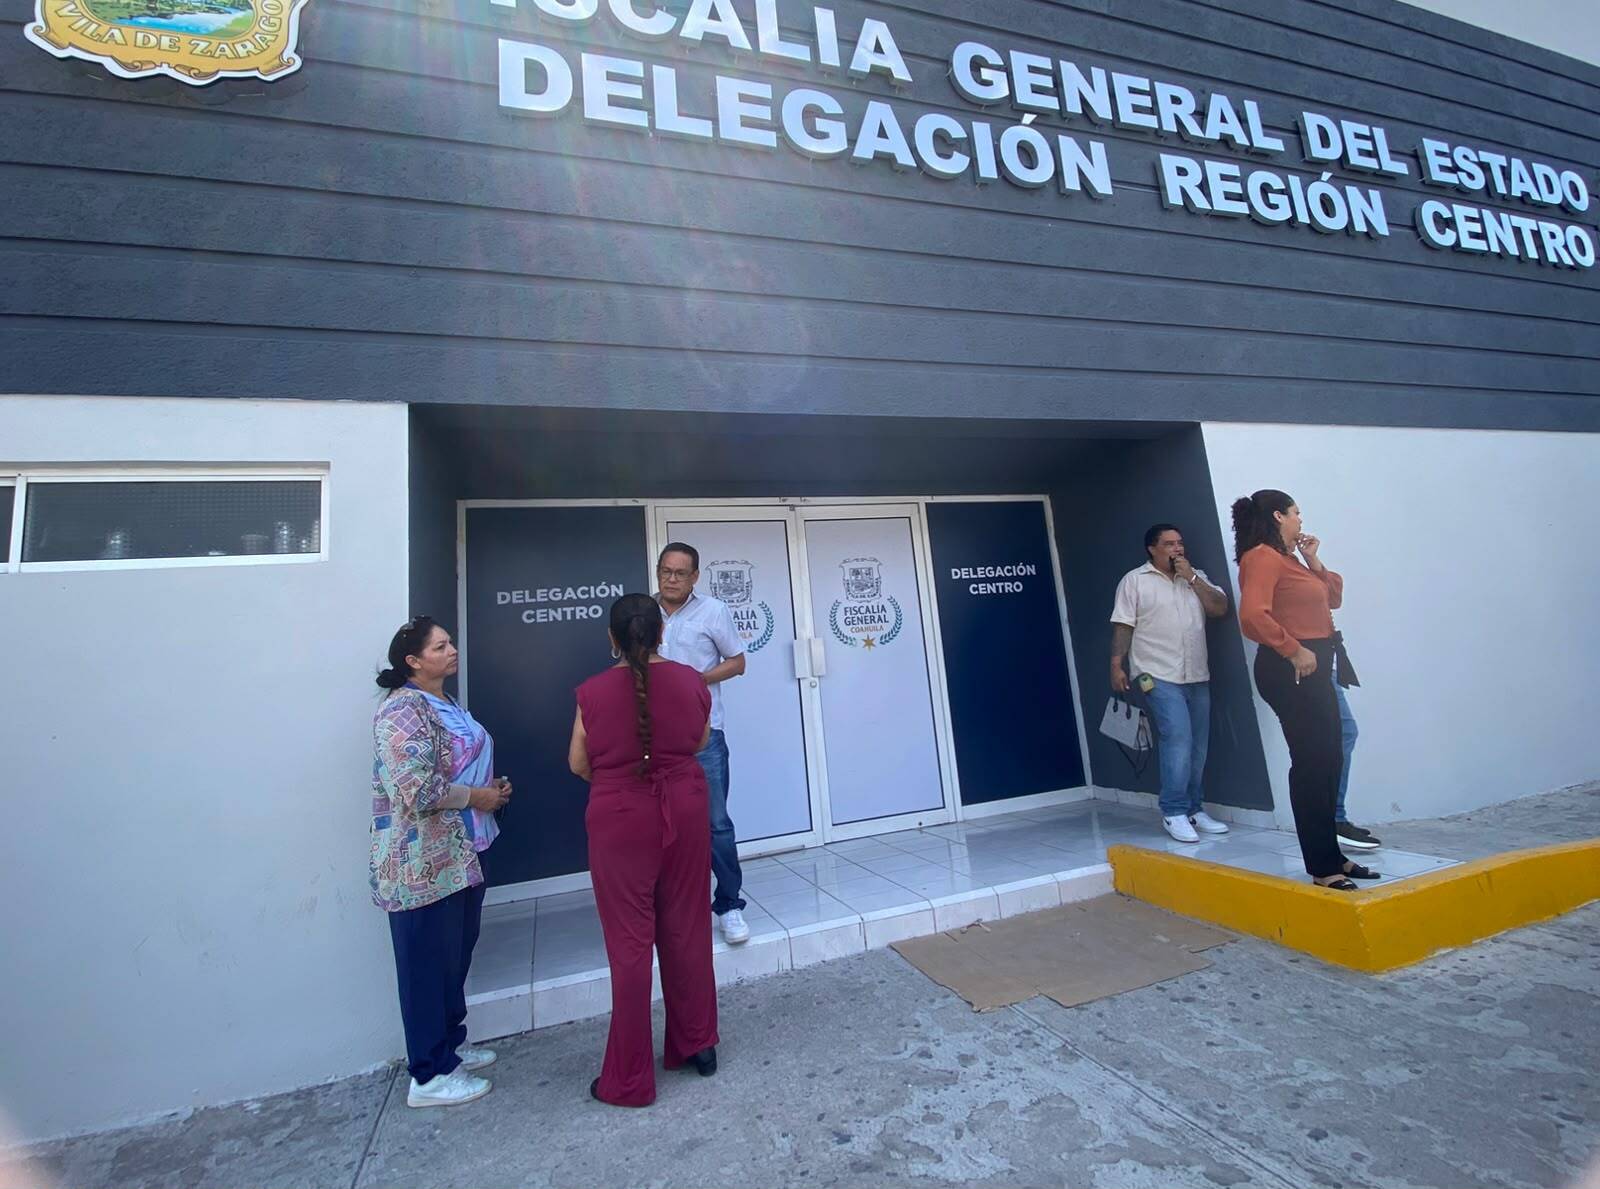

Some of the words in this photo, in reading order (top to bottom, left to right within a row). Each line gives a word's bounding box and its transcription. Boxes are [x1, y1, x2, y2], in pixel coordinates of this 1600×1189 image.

[134, 30, 182, 52] DE
[950, 40, 1286, 152] GENERAL
[1301, 110, 1410, 176] DEL
[1420, 137, 1590, 213] ESTADO
[497, 37, 1114, 197] DELEGACIÓN
[1158, 152, 1391, 237] REGIÓN
[1420, 199, 1596, 268] CENTRO
[951, 563, 1035, 579] DELEGACIÓN
[496, 581, 625, 605] DELEGACIÓN
[969, 582, 1023, 595] CENTRO
[521, 605, 604, 624] CENTRO
[844, 614, 889, 626] GENERAL
[850, 625, 884, 633] COAHUILA
